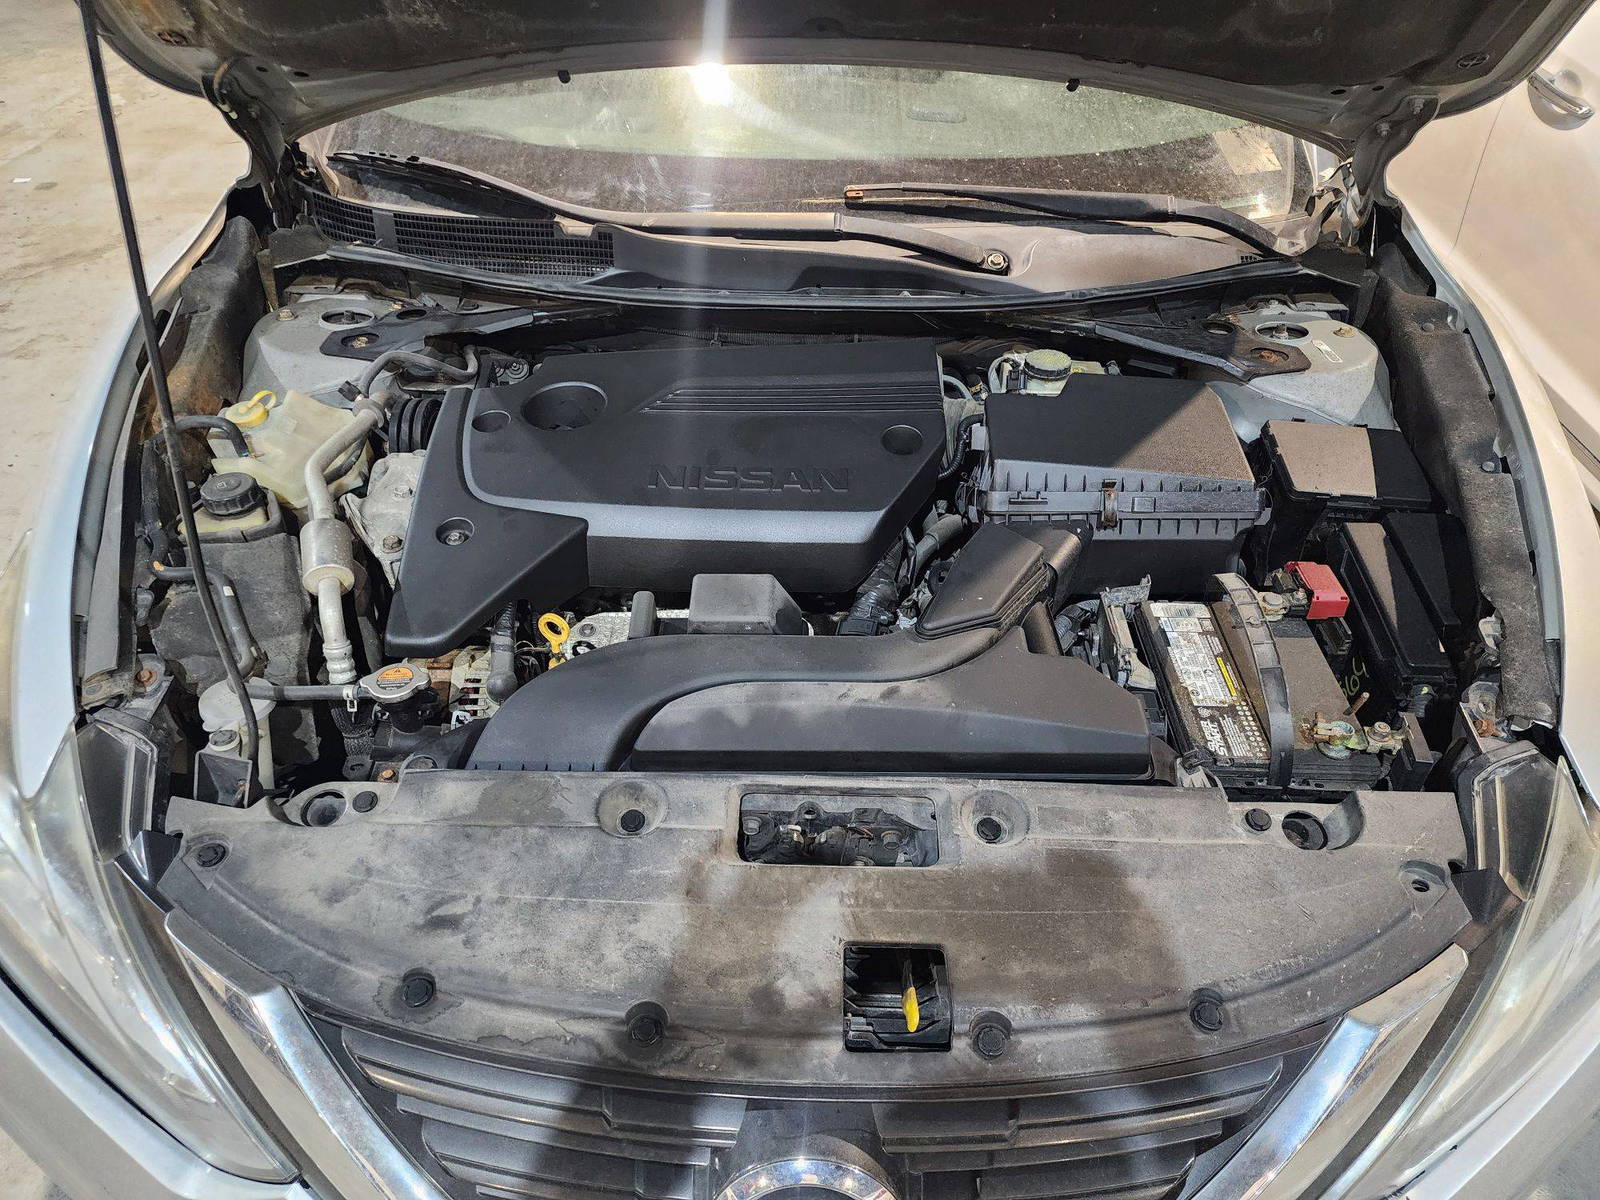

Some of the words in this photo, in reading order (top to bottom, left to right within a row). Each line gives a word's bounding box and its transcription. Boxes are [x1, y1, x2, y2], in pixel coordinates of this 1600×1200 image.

[648, 466, 849, 493] NISSAN
[1200, 720, 1217, 752] SUPER
[1207, 719, 1228, 757] START
